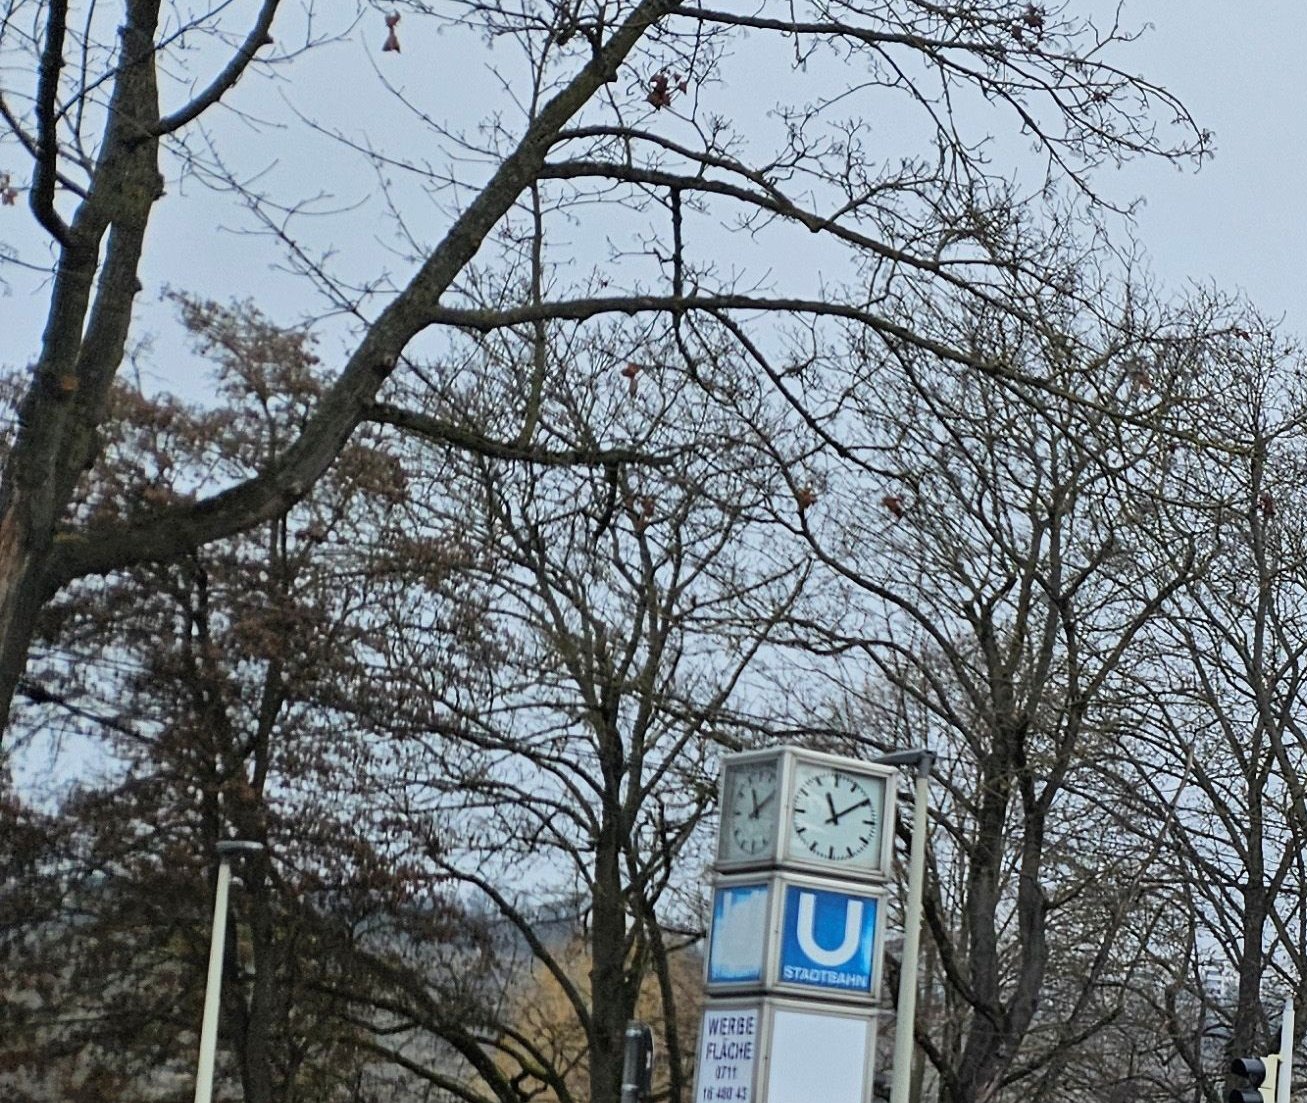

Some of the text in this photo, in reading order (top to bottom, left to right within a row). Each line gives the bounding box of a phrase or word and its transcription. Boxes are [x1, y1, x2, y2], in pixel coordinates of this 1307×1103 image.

[797, 892, 864, 967] U
[783, 965, 868, 987] STADTBAHN
[708, 1016, 754, 1036] WERBE
[705, 1038, 752, 1060] FLÄCHE
[715, 1065, 737, 1080] 0711
